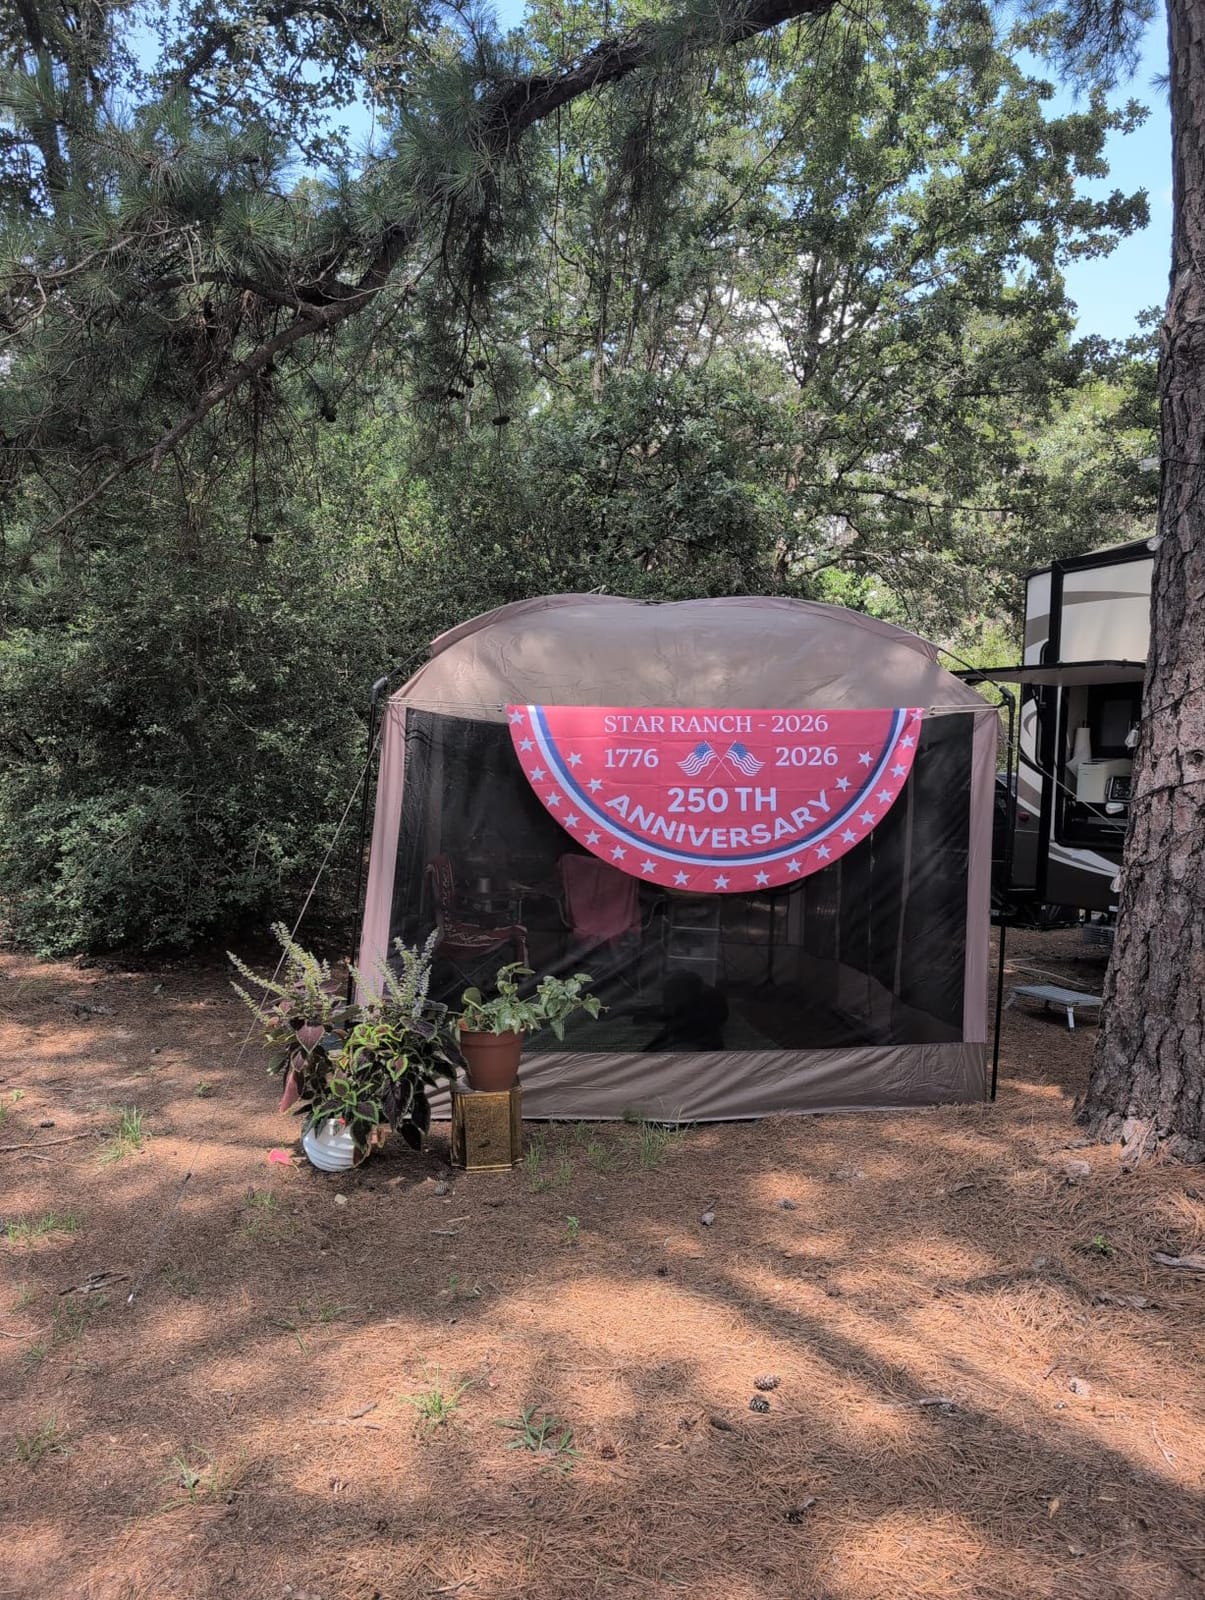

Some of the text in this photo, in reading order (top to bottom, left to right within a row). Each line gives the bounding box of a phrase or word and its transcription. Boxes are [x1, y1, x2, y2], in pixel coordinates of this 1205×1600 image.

[604, 715, 665, 733] STAR
[670, 715, 752, 733] RANCH
[771, 714, 829, 733] 2026
[604, 748, 660, 768] 1776
[775, 746, 839, 767] 2026
[667, 787, 777, 813] 250 TH
[605, 790, 831, 849] ANNIVERSARY
